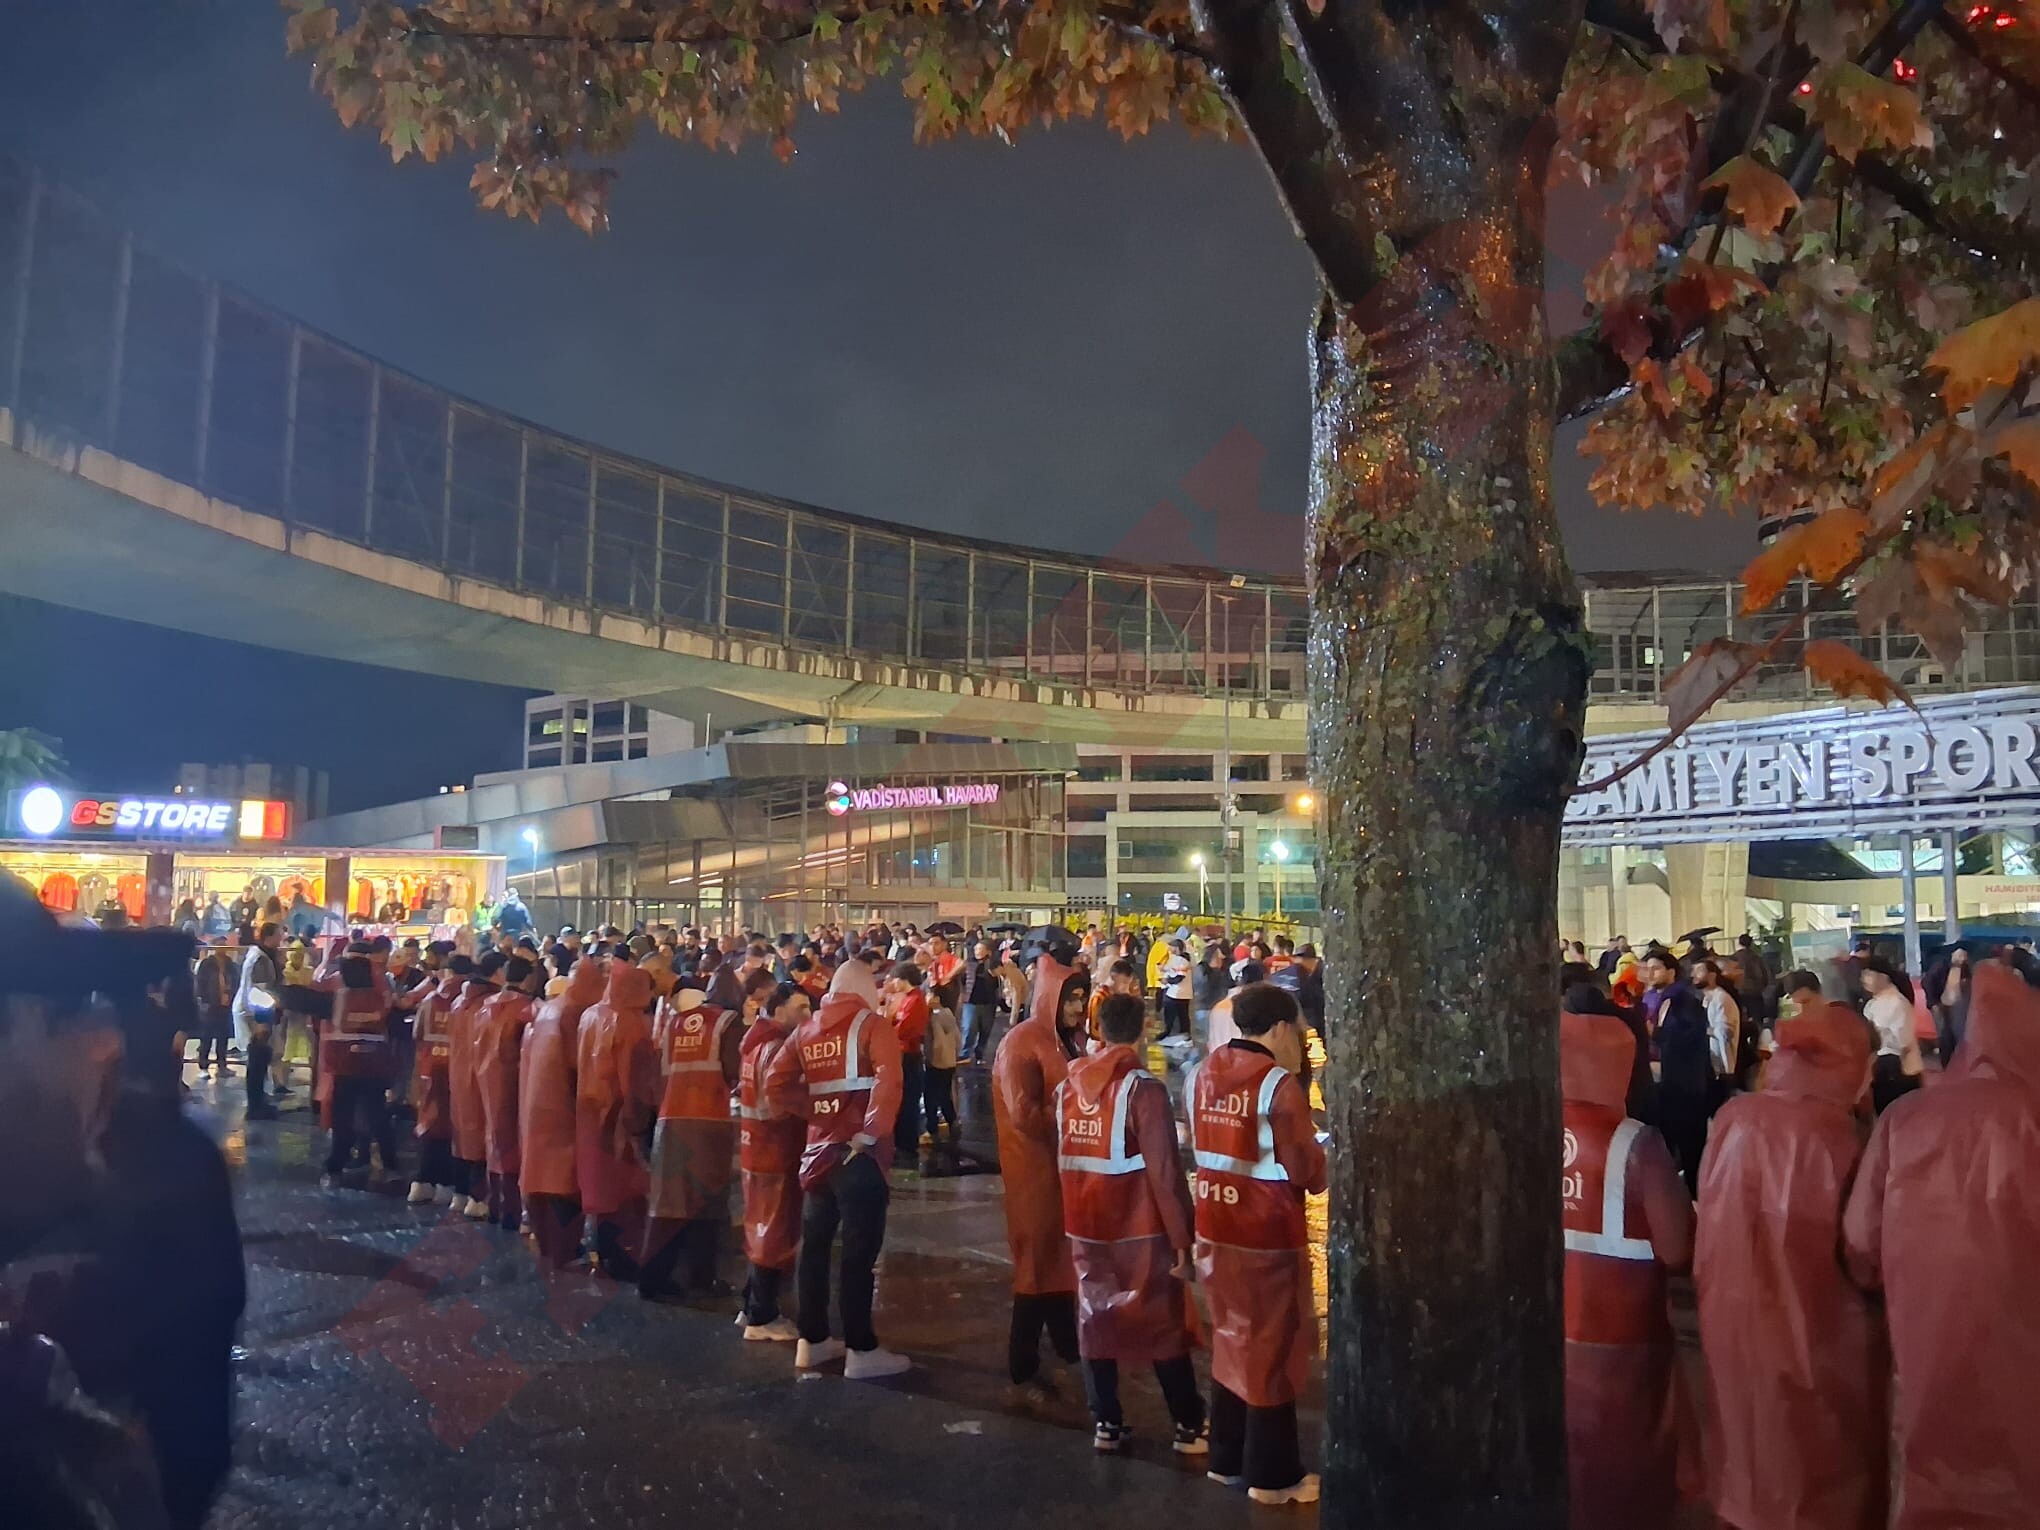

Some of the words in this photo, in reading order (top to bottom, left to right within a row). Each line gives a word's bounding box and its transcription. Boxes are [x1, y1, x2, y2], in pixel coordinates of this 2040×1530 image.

[1706, 739, 1827, 806] YEN
[1851, 720, 2040, 799] SPOR
[852, 783, 943, 810] VADİSTANBUL
[945, 784, 999, 806] HAVARAY
[803, 1035, 841, 1062] REDİ
[1068, 1116, 1103, 1137] REDİ
[1198, 1180, 1240, 1205] 019
